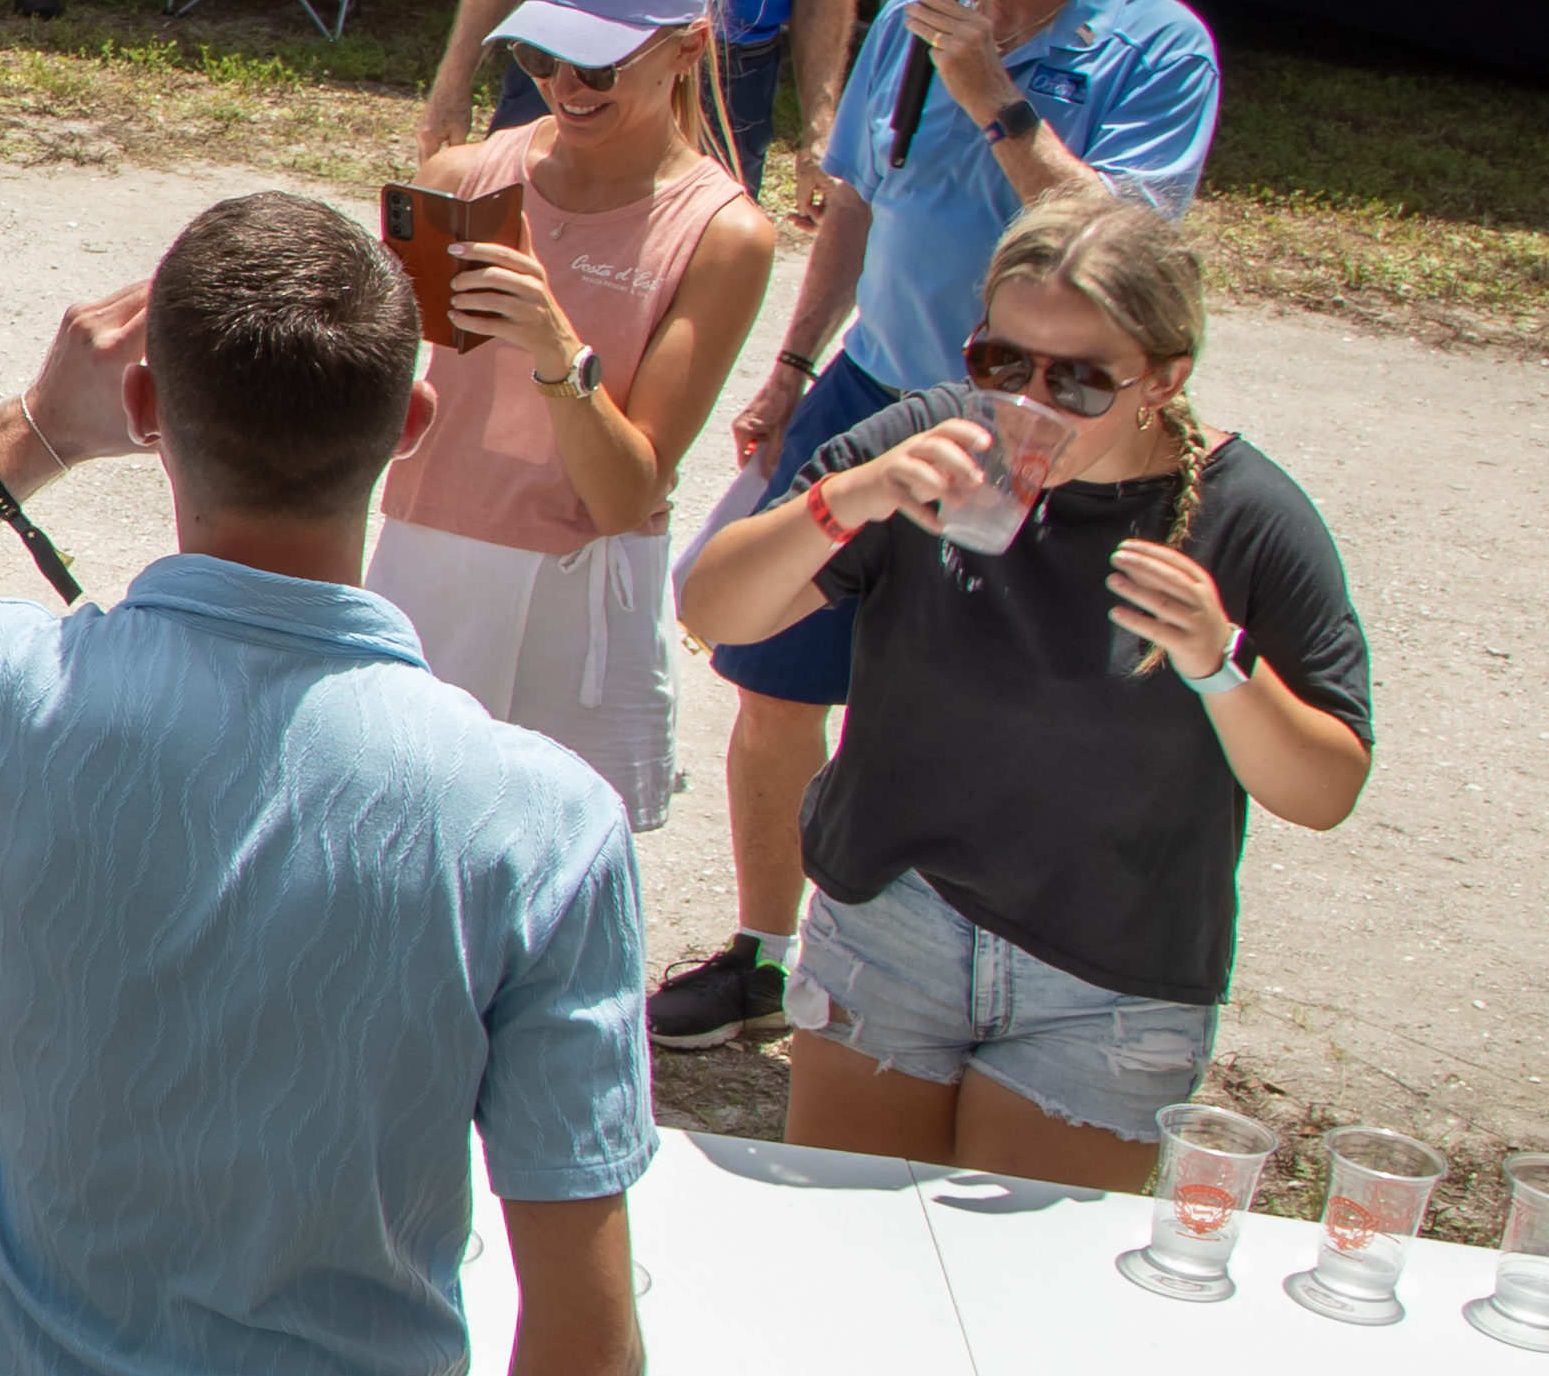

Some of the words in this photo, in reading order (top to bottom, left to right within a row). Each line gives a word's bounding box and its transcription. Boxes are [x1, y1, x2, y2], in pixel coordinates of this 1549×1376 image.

[571, 254, 614, 277] Costa
[581, 275, 602, 285] BEACH
[603, 281, 628, 293] RESORT
[637, 291, 649, 299] SPA
